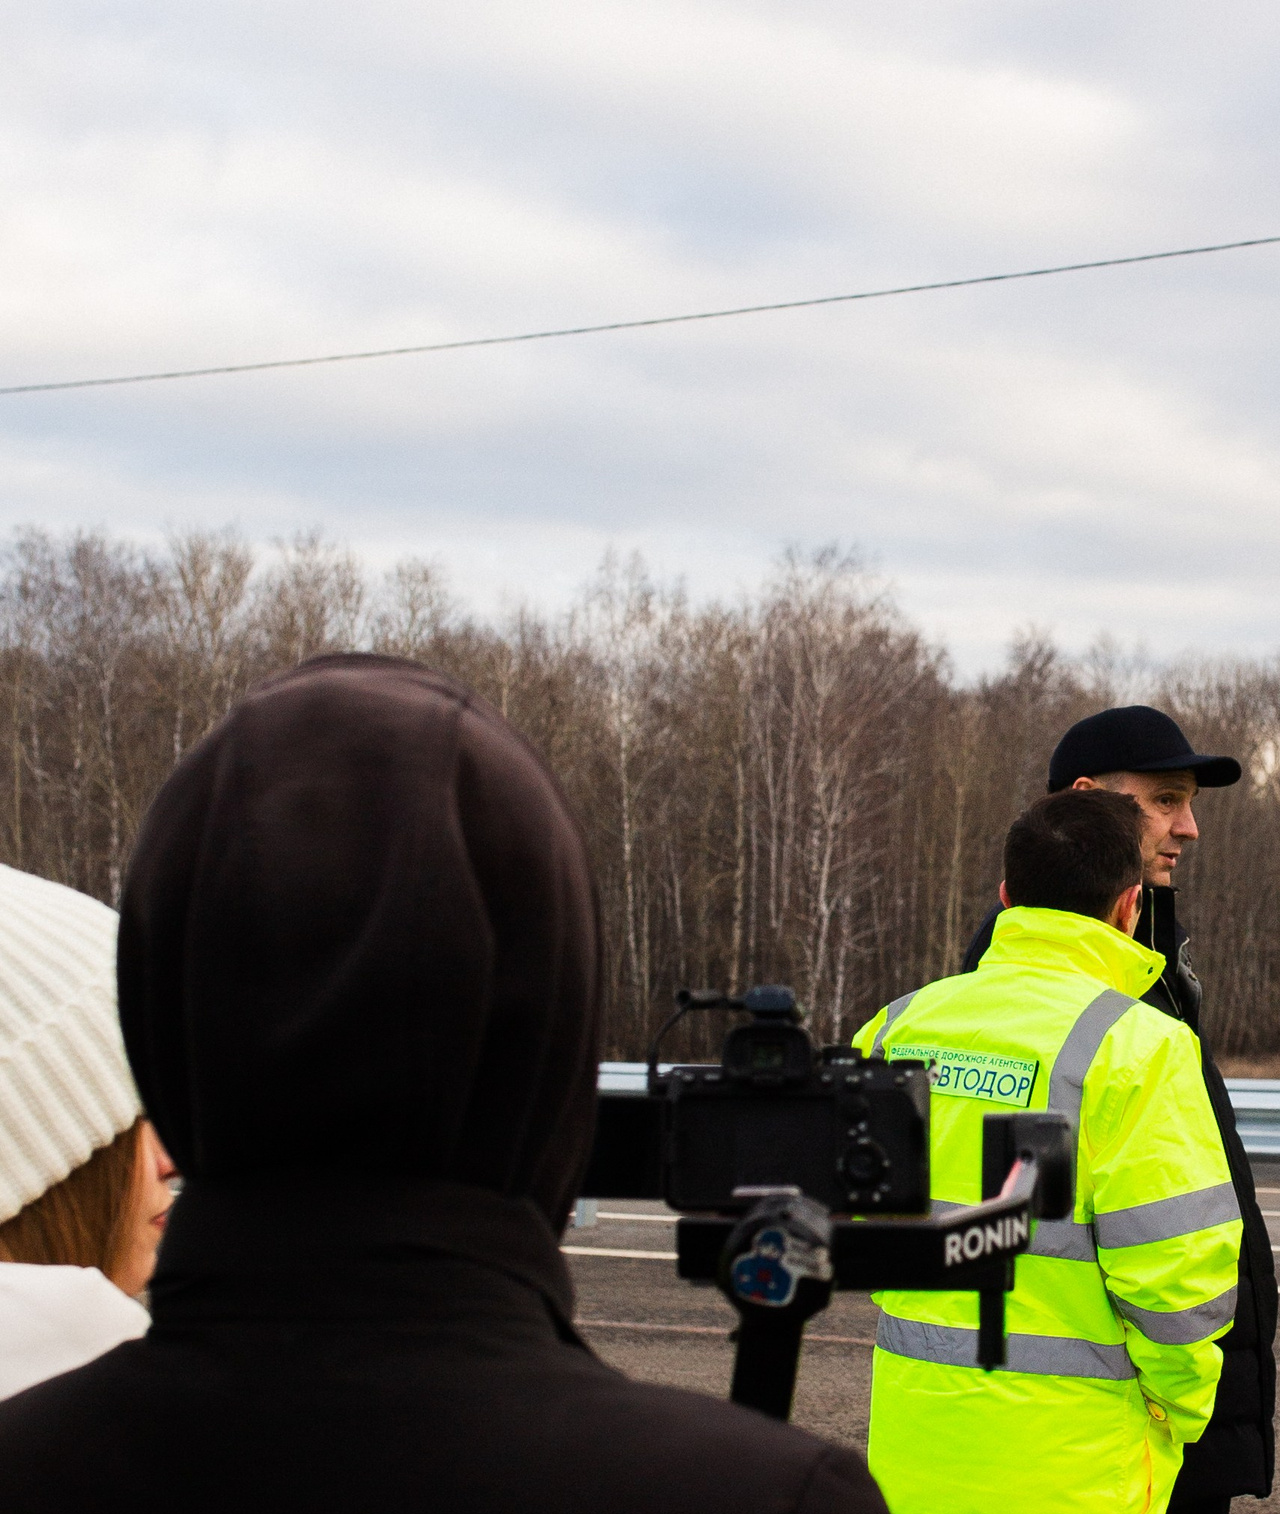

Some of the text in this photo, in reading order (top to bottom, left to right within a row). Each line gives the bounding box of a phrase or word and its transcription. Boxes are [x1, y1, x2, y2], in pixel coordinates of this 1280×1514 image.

[891, 1047, 1035, 1073] ФЕДЕРАЛЬНОЕ ДОРОЖНОЕ АГЕНТСТВО
[931, 1065, 1031, 1098] ВТОДОР
[944, 1213, 1030, 1267] RONIN
